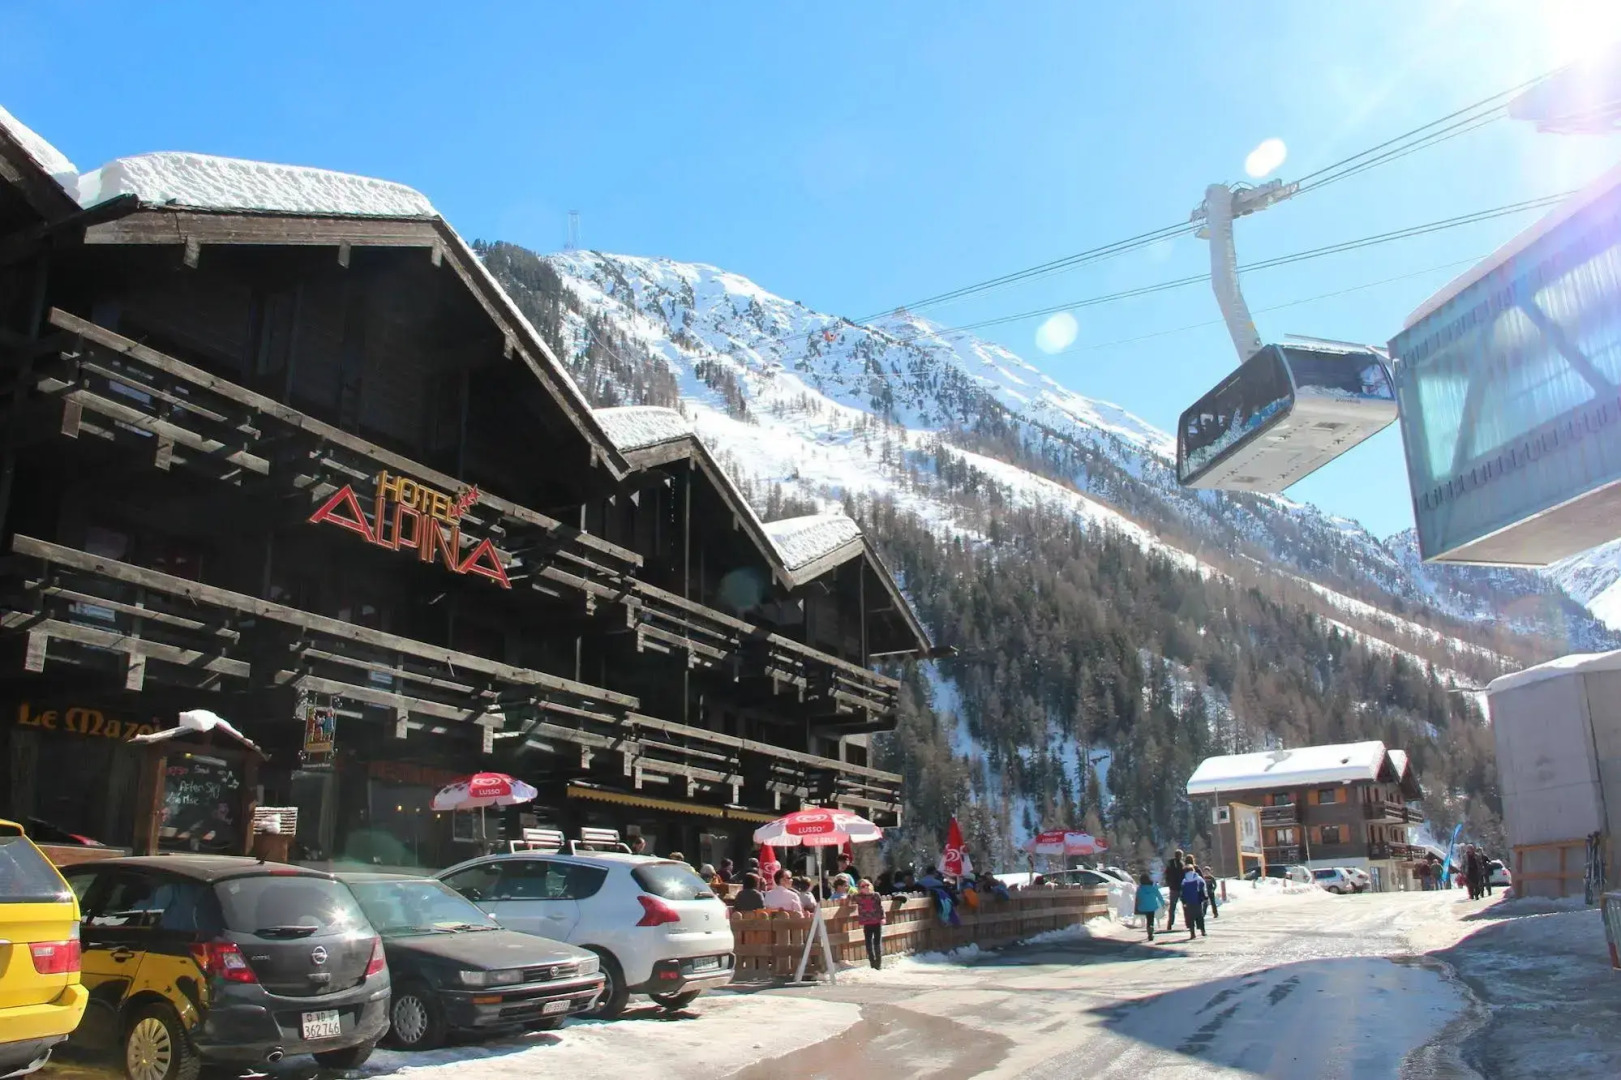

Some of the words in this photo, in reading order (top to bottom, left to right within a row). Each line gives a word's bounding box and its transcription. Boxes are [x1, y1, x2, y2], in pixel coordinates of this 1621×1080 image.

[376, 470, 461, 526] HOTEL
[308, 484, 512, 589] ALPINA
[798, 826, 823, 834] LUSSO
